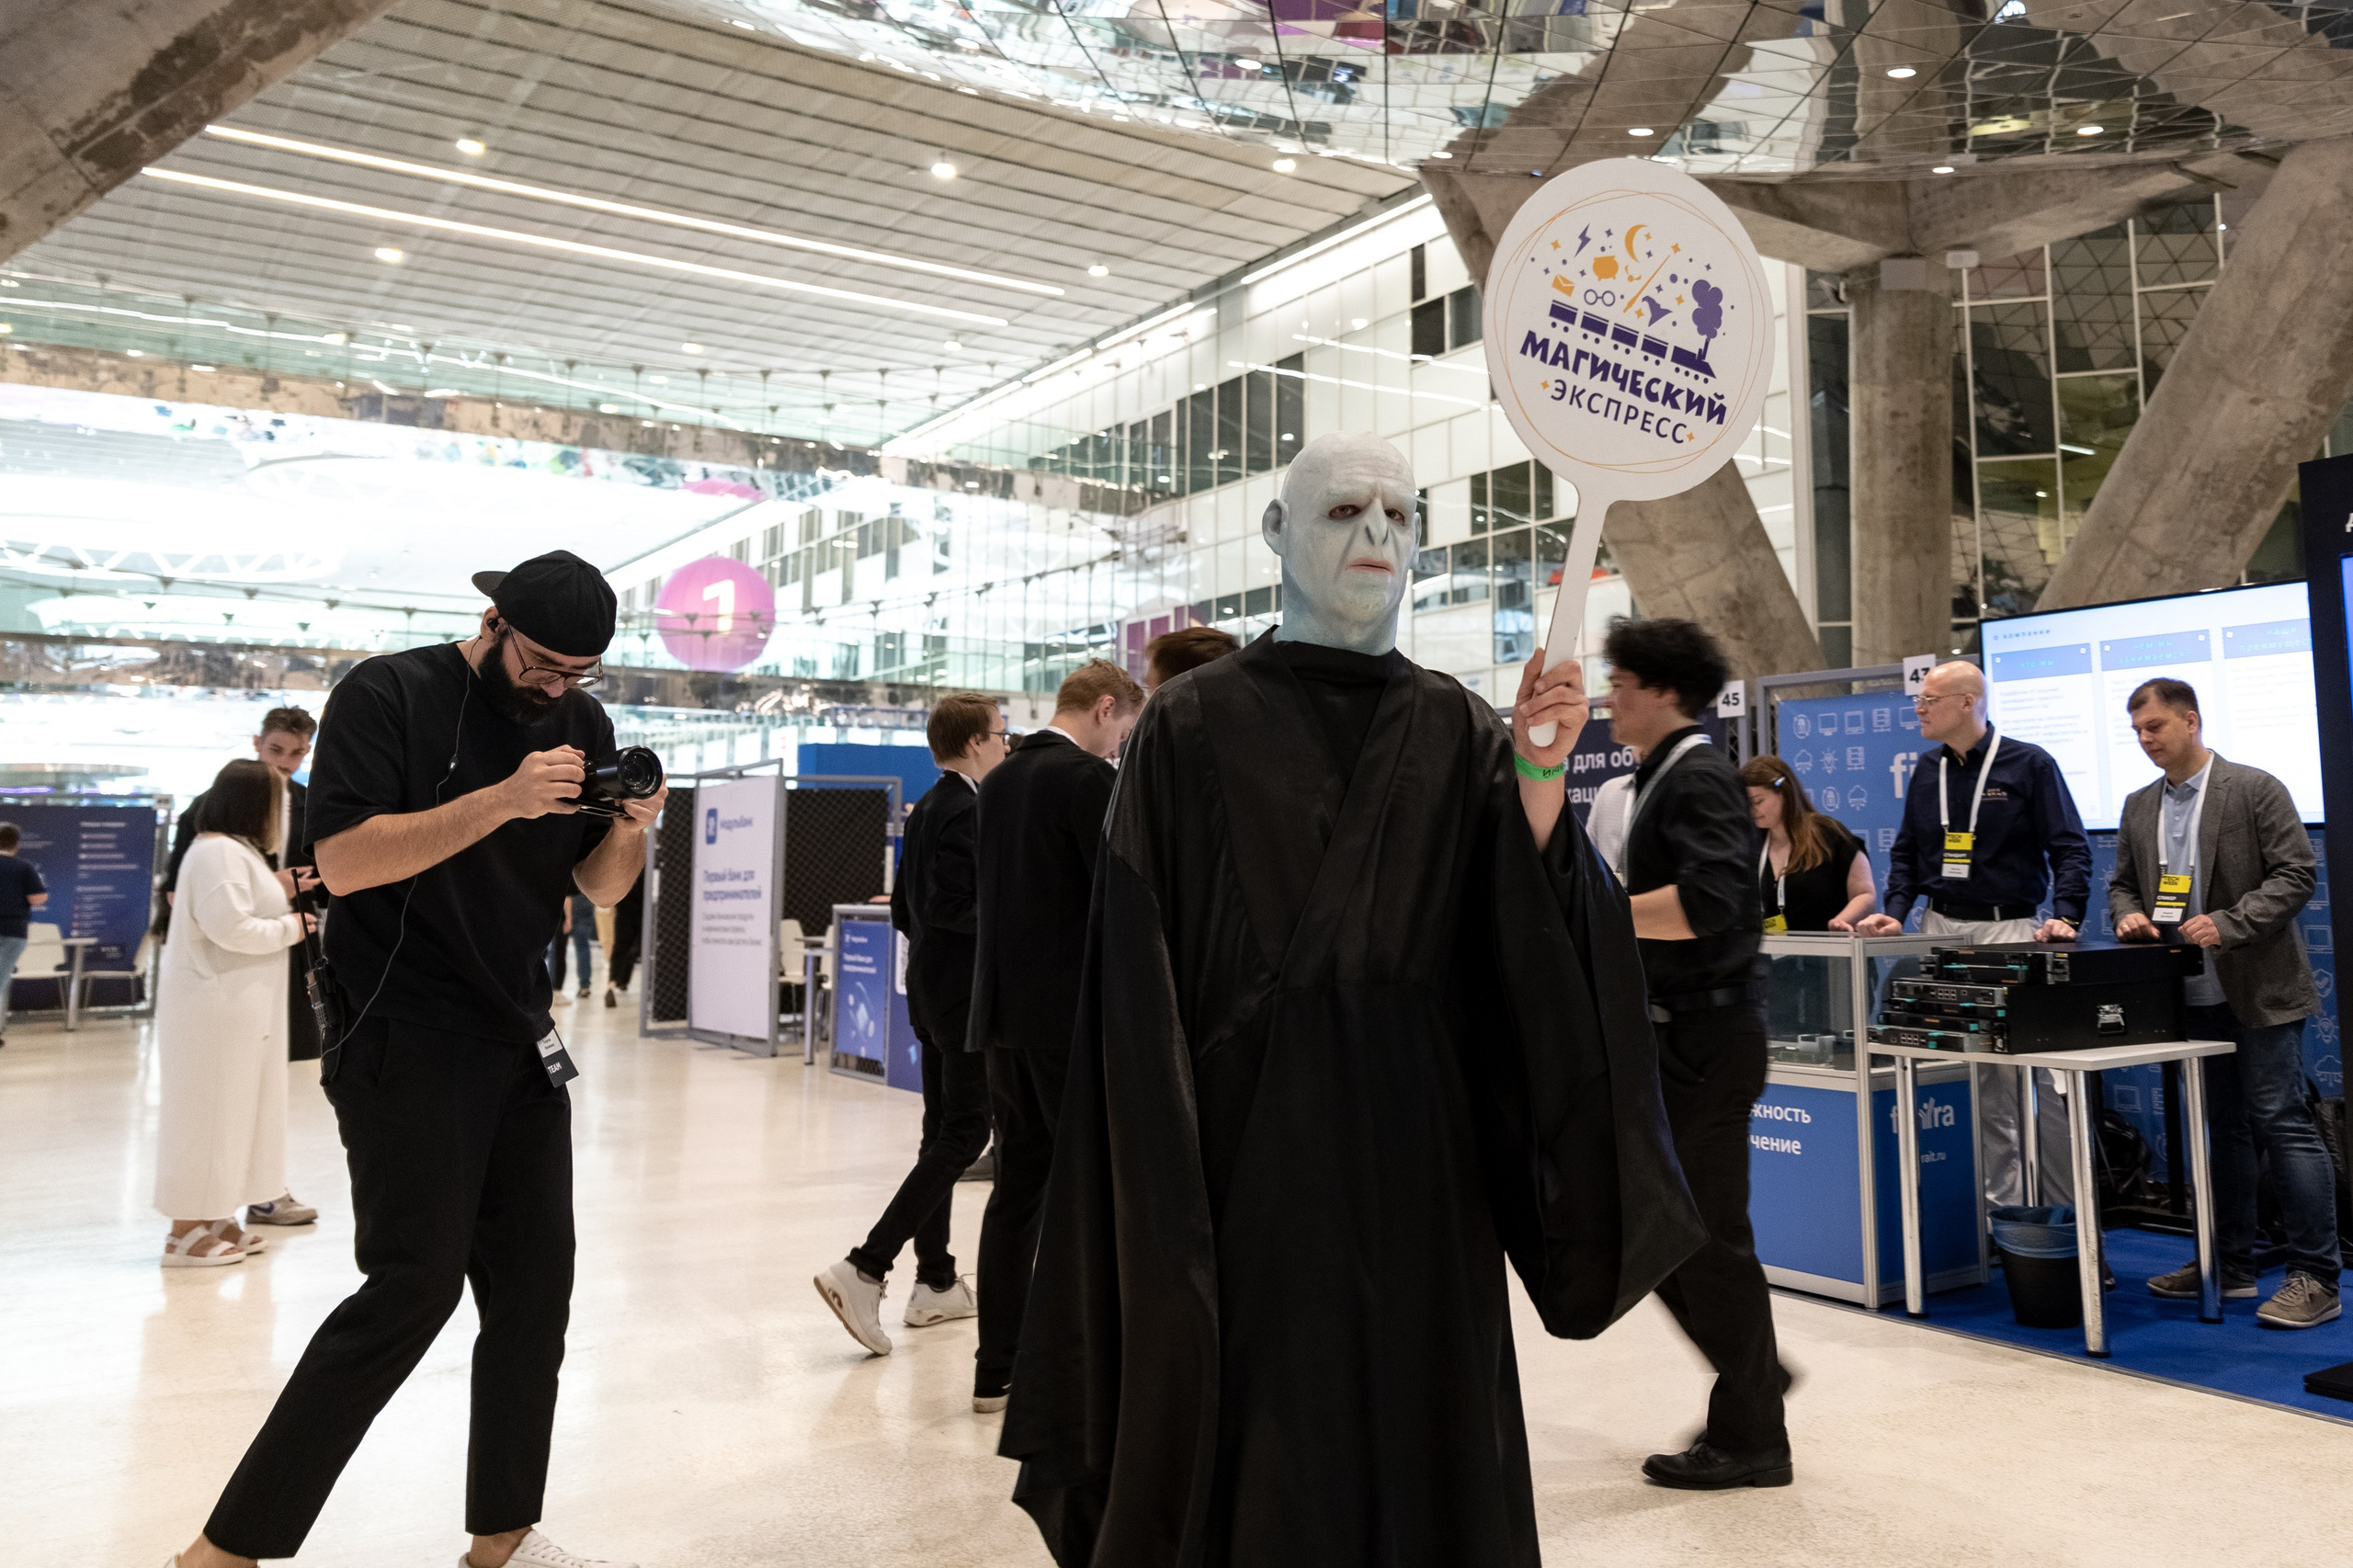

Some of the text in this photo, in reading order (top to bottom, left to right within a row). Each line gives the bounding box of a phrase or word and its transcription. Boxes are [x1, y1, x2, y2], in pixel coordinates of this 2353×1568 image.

[1519, 330, 1727, 425] МАГИЧЕСКИЙ
[1551, 379, 1688, 445] ЭКСПРЕСС
[702, 579, 735, 632] 1
[1722, 692, 1740, 707] 45
[1573, 753, 1606, 774] для
[547, 1062, 563, 1074] TEAM
[1749, 1134, 1802, 1155] чение
